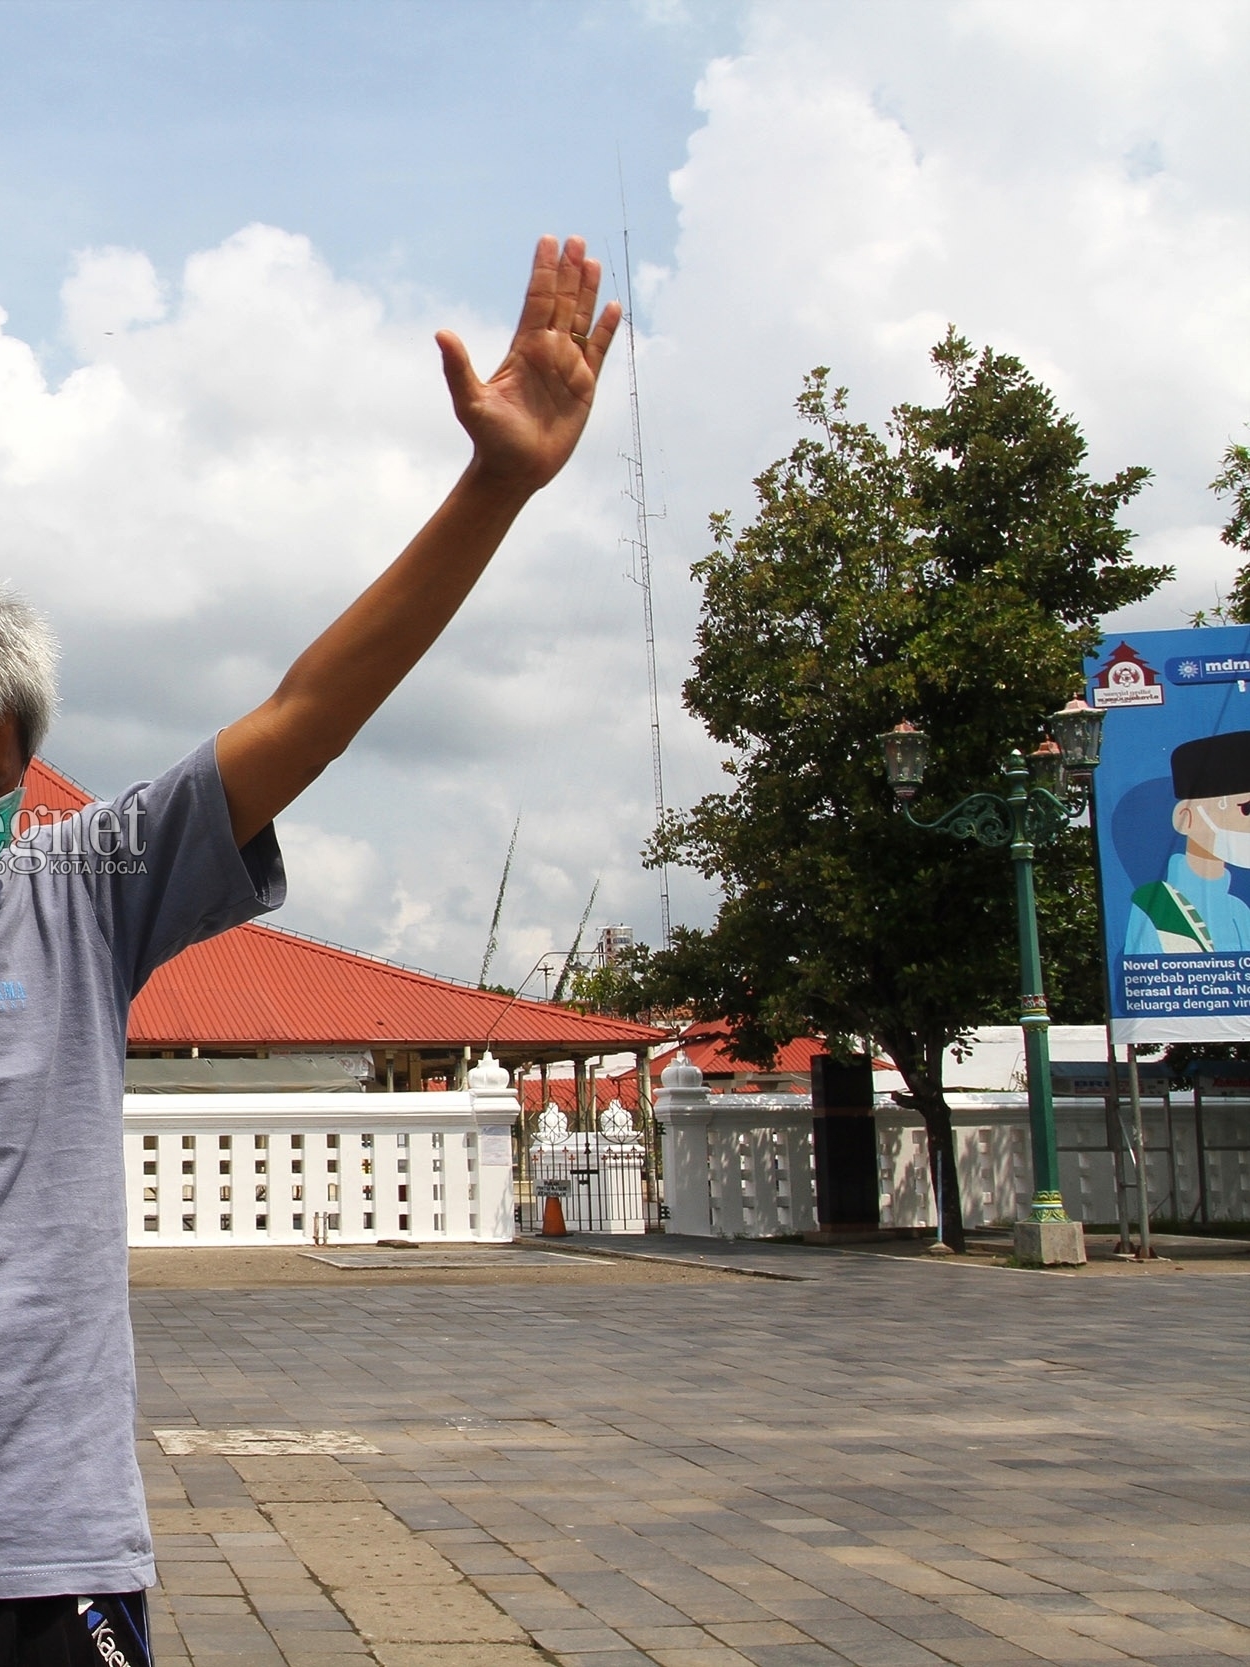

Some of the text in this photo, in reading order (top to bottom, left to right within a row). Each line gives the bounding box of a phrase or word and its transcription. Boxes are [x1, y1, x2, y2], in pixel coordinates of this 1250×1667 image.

[1123, 959, 1158, 970] Novel
[1162, 958, 1235, 969] coronavirus
[1124, 972, 1184, 985] penyebab
[1188, 971, 1241, 984] penyakit
[1125, 986, 1170, 997] berasal
[1174, 985, 1198, 996] dari
[1201, 985, 1233, 995] Cina.
[1126, 1000, 1180, 1012] keluarga
[1183, 999, 1230, 1011] dengan
[91, 1618, 131, 1667] Kae
